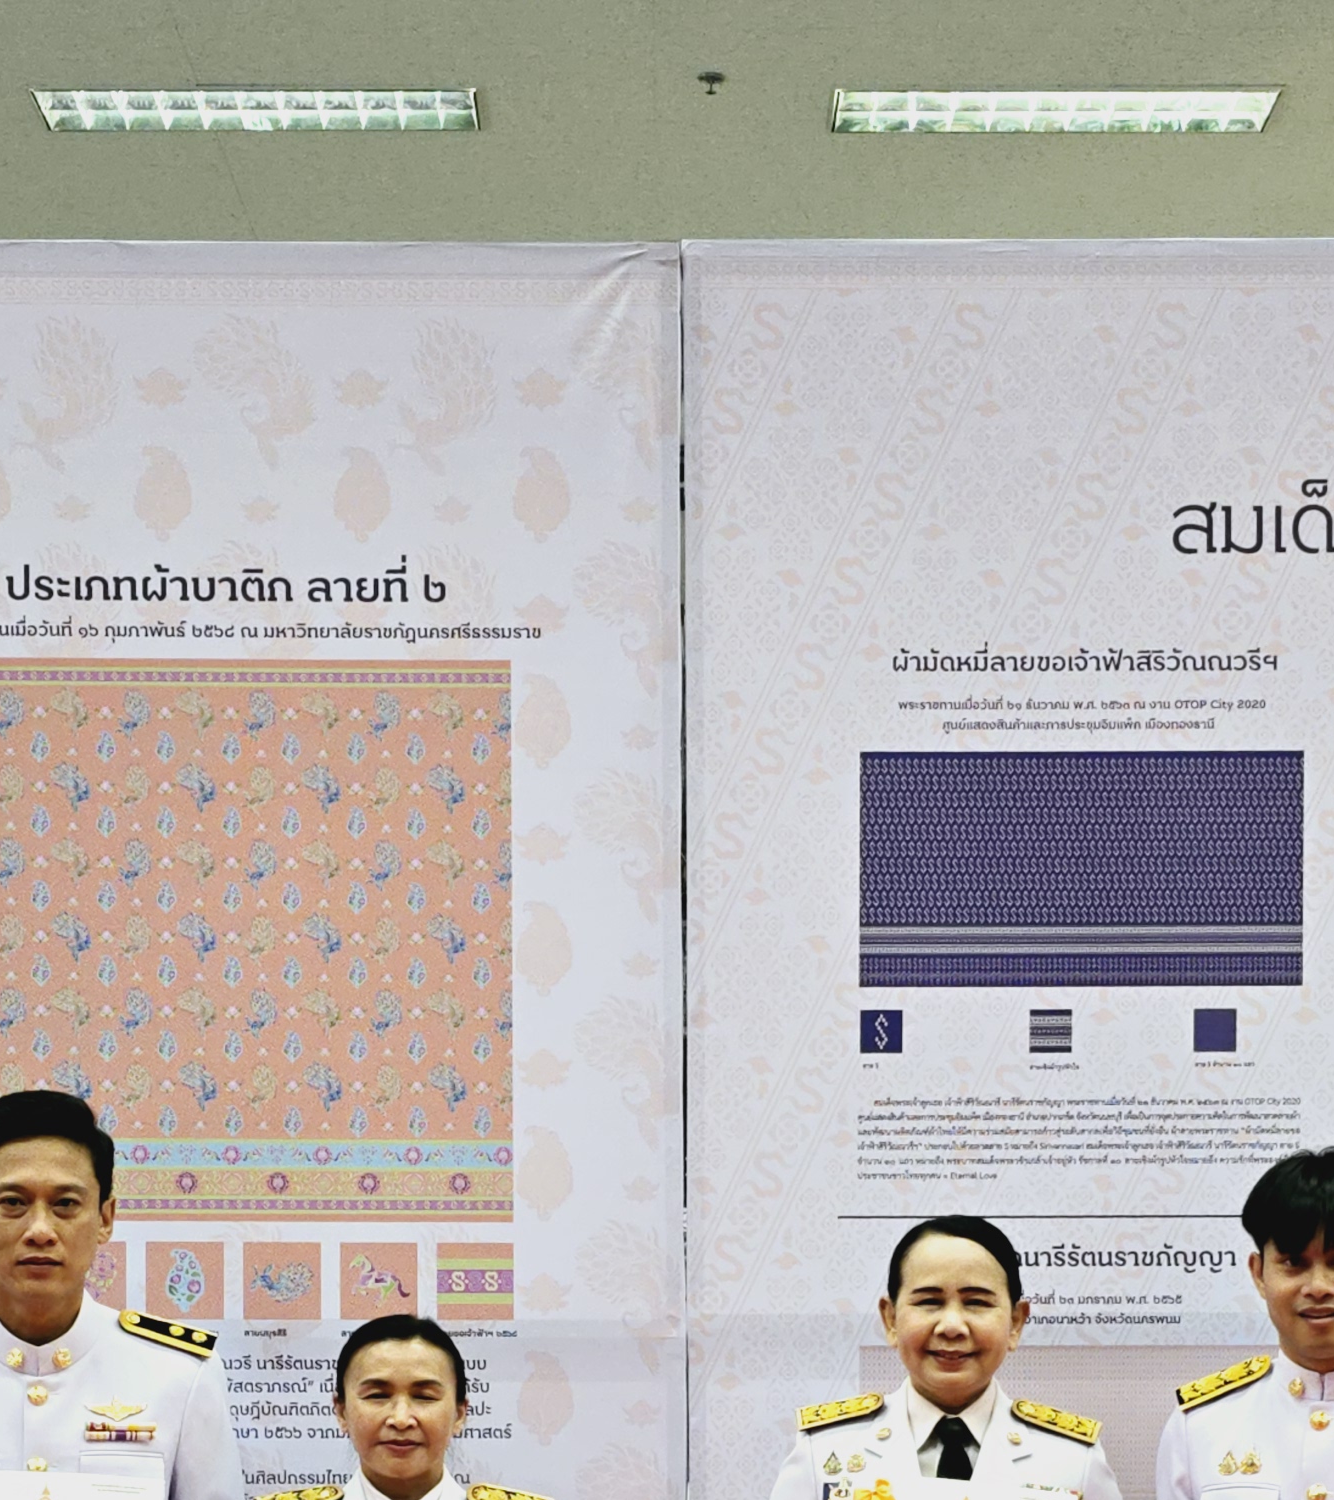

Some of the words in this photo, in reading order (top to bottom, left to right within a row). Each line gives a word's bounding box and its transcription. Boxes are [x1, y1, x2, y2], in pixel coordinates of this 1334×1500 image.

[5, 563, 294, 603] ประเภทผ้าบาติก
[307, 554, 409, 603] ลายที่
[423, 573, 446, 603] ๒
[78, 623, 99, 639] ๑๖
[104, 620, 187, 644] กุมภาพันธ์
[191, 624, 235, 638] ๒๕๖๘
[240, 626, 259, 639] ณ
[263, 621, 542, 644] มหาวิทยาลัยราชภัฏนครศรีธรรมราช
[892, 641, 1278, 672] ผ้ามัดหมี่ลายขอเจ้าฟ้าสิริวัณณวรีฯ
[1174, 699, 1208, 710] OTOP
[1209, 699, 1234, 713] City
[1236, 698, 1267, 710] 2020
